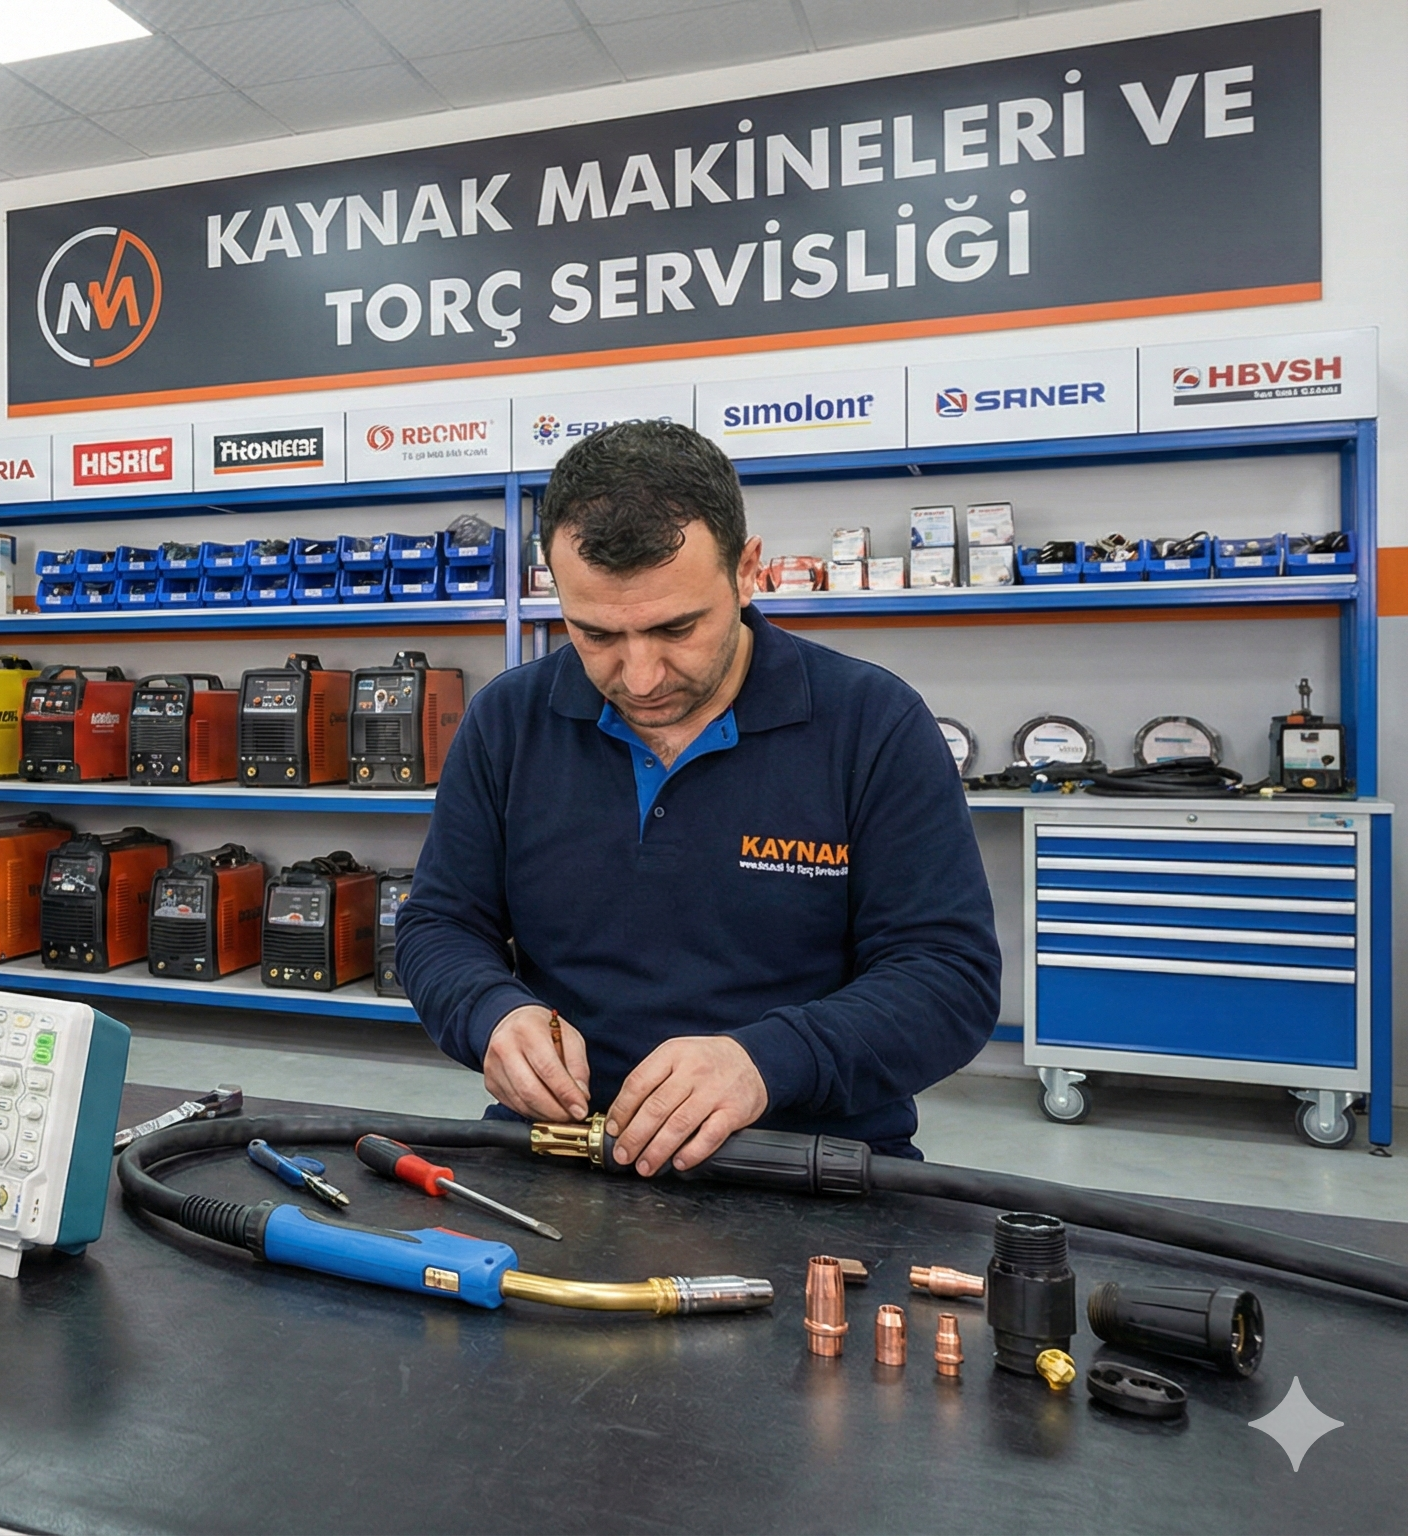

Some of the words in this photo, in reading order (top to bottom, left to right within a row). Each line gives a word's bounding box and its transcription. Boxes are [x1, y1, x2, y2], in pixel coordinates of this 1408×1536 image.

[206, 172, 514, 269] KAYNAK
[536, 68, 1086, 227] MAKİNELERİ
[1118, 64, 1255, 147] VE
[324, 269, 522, 348] TORÇ
[547, 188, 1031, 325] SERVİSLİĞİ
[1208, 355, 1342, 388] HBVSH
[741, 835, 849, 865] KAYNAK
